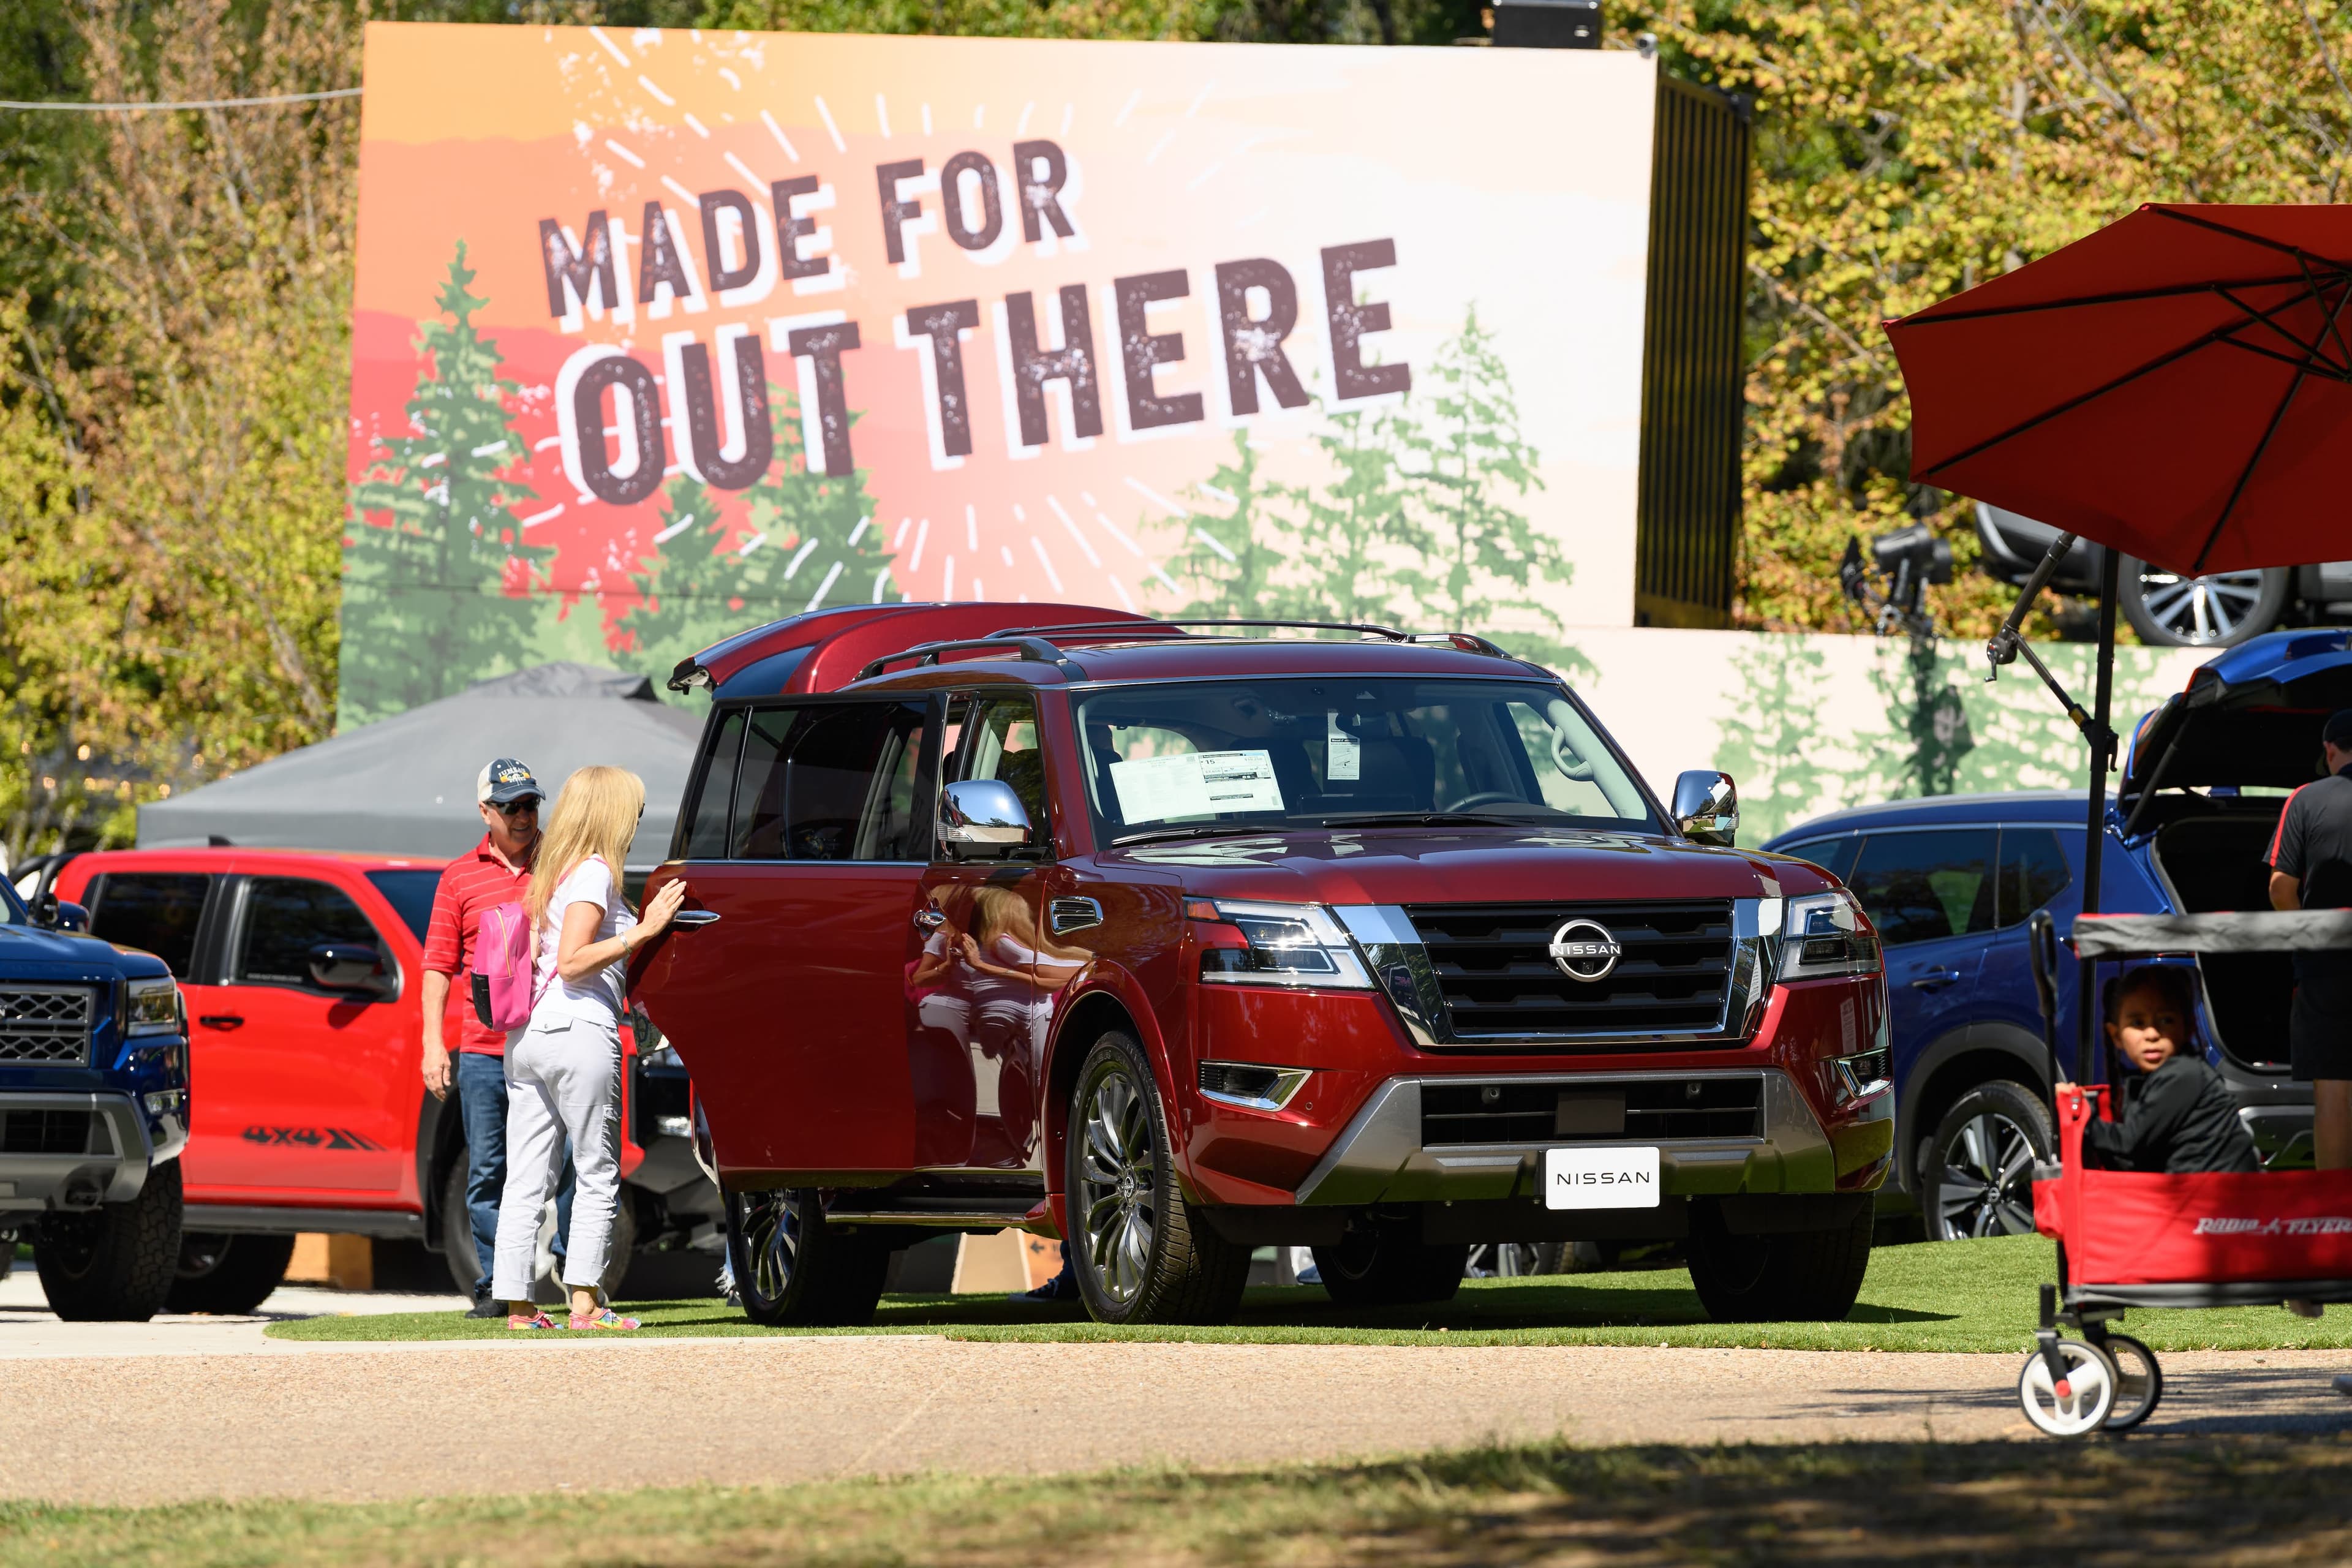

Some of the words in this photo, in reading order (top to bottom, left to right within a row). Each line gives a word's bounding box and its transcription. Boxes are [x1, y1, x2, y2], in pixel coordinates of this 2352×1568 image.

[540, 175, 830, 317] MADE
[876, 139, 1076, 263] FOR
[573, 322, 861, 506] OUT
[907, 238, 1411, 457] THERE
[1551, 944, 1621, 956] NISSAN
[1557, 1170, 1650, 1186] NISSAN
